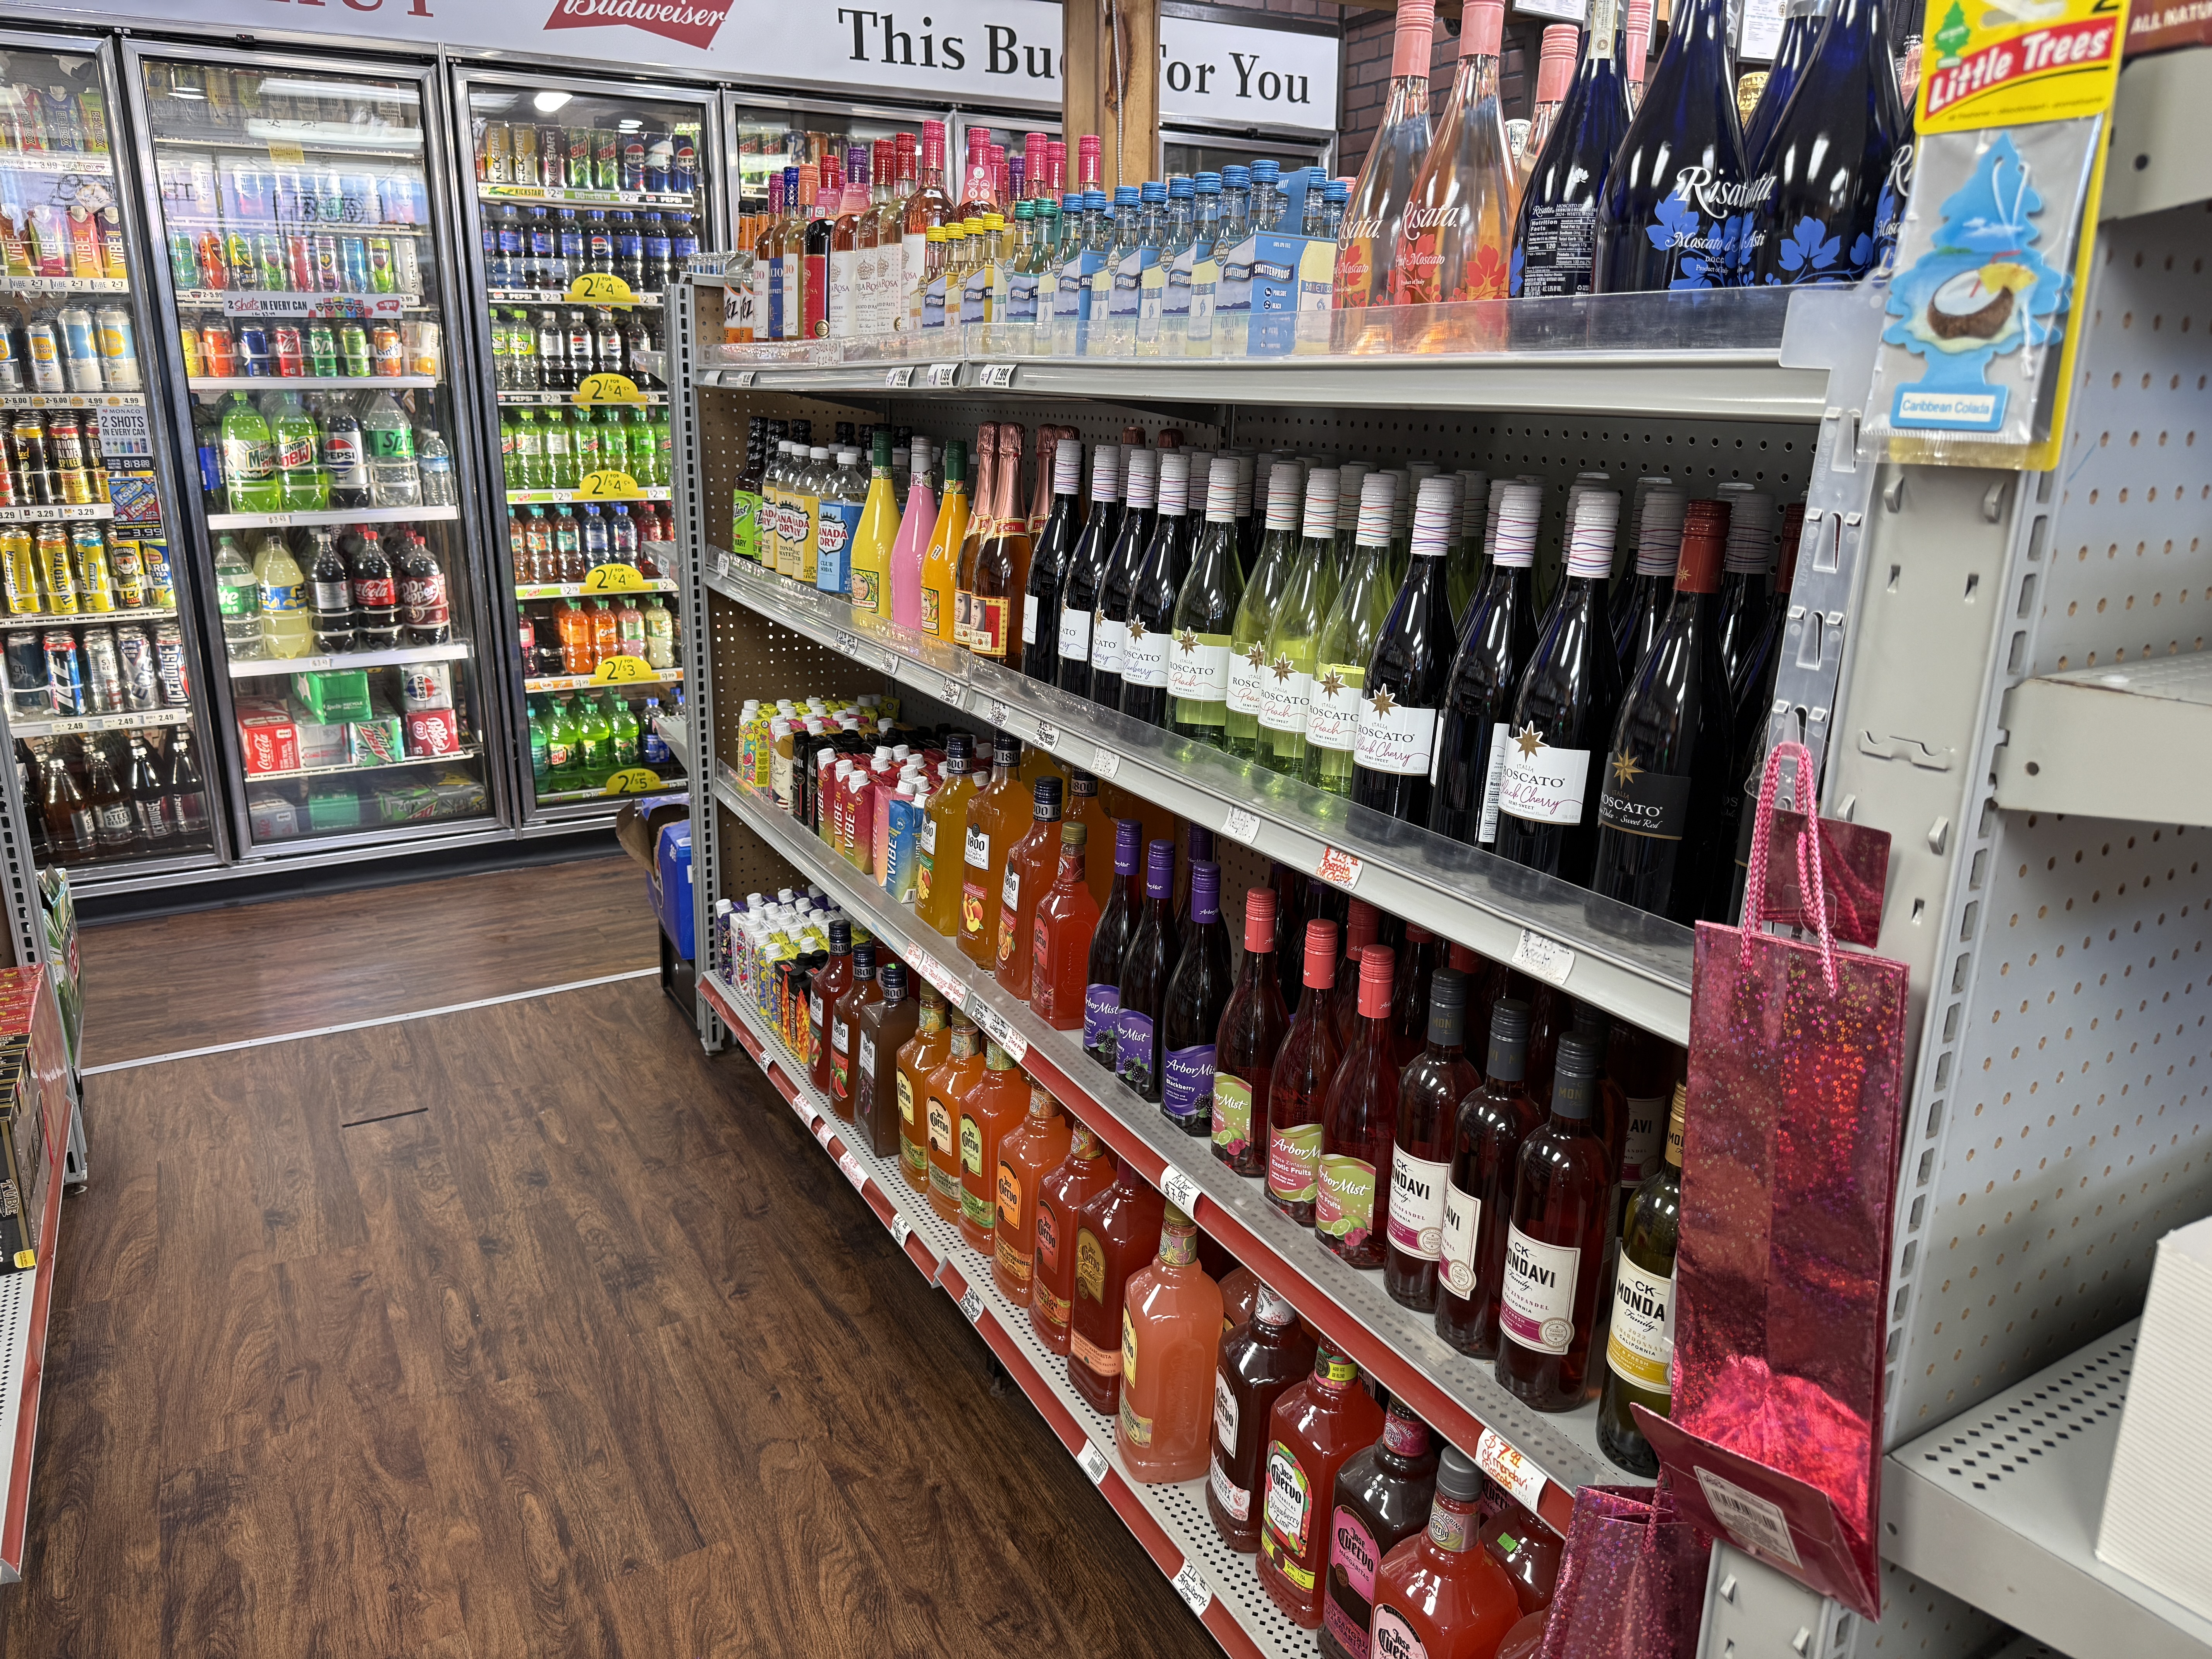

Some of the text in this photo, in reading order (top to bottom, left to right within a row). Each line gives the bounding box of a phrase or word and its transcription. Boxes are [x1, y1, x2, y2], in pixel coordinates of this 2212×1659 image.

[2131, 17, 2160, 35] ALL
[838, 8, 1062, 78] This Bu
[1160, 44, 1310, 103] or You
[1928, 26, 2109, 113] Little Trees
[20, 110, 36, 145] BEATBOX
[56, 111, 72, 147] BEATBOX
[91, 111, 105, 148] BEATBOX
[515, 189, 544, 197] KICKSTART
[1666, 231, 1721, 248] Moscato
[1407, 253, 1445, 266] Moscato
[1225, 267, 1250, 278] SHATTERPROOF
[1255, 263, 1290, 279] SHATTERPROOF
[228, 298, 307, 311] 2 Shots IN EVERY CAN
[940, 369, 951, 381] 7.99
[995, 368, 1008, 380] 7.99
[1902, 400, 1990, 415] Caribbean Colada
[101, 416, 144, 428] 2 SHOTS
[54, 449, 82, 459] PALMER
[820, 537, 836, 547] DRY
[162, 647, 187, 702] ICEHOUSE
[1170, 662, 1213, 675] ROSCATO
[1170, 672, 1196, 687] Peach
[1261, 689, 1309, 705] ROSCATO
[1262, 701, 1291, 717] Peach
[1309, 705, 1358, 722] ROSCATO
[1310, 718, 1340, 734] Peach
[1358, 724, 1413, 743] ROSCATO
[1356, 733, 1412, 766] Black Cherry
[1503, 766, 1563, 787] ROSCATO
[1517, 764, 1534, 773] ITALIA
[1072, 781, 1092, 792] 1800
[1500, 776, 1560, 814] Black Cherry
[1612, 790, 1629, 800] ITALIA
[922, 821, 933, 837] 1800
[1621, 815, 1641, 825] Sweet
[1643, 819, 1662, 828] Red
[968, 836, 984, 851] 1800
[1004, 875, 1016, 892] 1800
[830, 943, 849, 951] 1800
[855, 967, 875, 977] 1800
[884, 988, 902, 997] 1800
[1099, 1001, 1118, 1014] Mist
[834, 1024, 846, 1038] 1800
[1125, 1029, 1150, 1042] Mist
[863, 1039, 872, 1058] 1800
[1166, 1059, 1199, 1077] Arbor
[1166, 1073, 1178, 1082] Merlot
[1166, 1079, 1195, 1092] Blackberry
[1222, 1096, 1249, 1111] Mist
[930, 1111, 949, 1135] Cuervo
[962, 1131, 979, 1154] Cuervo
[1272, 1139, 1309, 1156] Arbor
[1272, 1153, 1312, 1169] White Zinfandel
[1272, 1159, 1312, 1176] Exotic Fruits
[1396, 1158, 1409, 1172] CK
[1172, 1174, 1194, 1191] Arbor
[1317, 1164, 1372, 1196] Arbor Mist
[1, 1179, 19, 1216] TUBE
[999, 1178, 1017, 1205] Cuervo
[1037, 1219, 1056, 1248] Cuervo
[1081, 1245, 1100, 1272] Cuervo
[1515, 1242, 1530, 1258] CK
[1508, 1269, 1532, 1291] Family
[1635, 1281, 1657, 1297] CK
[1505, 1292, 1532, 1314] CALIFORNIA
[1511, 1290, 1549, 1310] ZINFANDEL
[1625, 1309, 1657, 1332] Family
[1616, 1324, 1663, 1352] CHARDONNAY
[1629, 1328, 1646, 1340] 2022
[1620, 1334, 1656, 1356] CALIFORNIA
[1628, 1353, 1648, 1366] FRESH
[1216, 1390, 1234, 1427] Cuervo
[1279, 1462, 1293, 1483] Jose
[1271, 1463, 1302, 1504] Cuervo
[1273, 1485, 1297, 1511] MARGARITAS
[1268, 1496, 1300, 1525] Strawberry
[1274, 1513, 1290, 1529] Lime
[1431, 1516, 1449, 1540] Cuervo
[1443, 1513, 1463, 1534] DRINK
[1351, 1527, 1365, 1548] Jose
[1338, 1528, 1374, 1571] Cuervo
[1338, 1548, 1370, 1582] MARGARITAS
